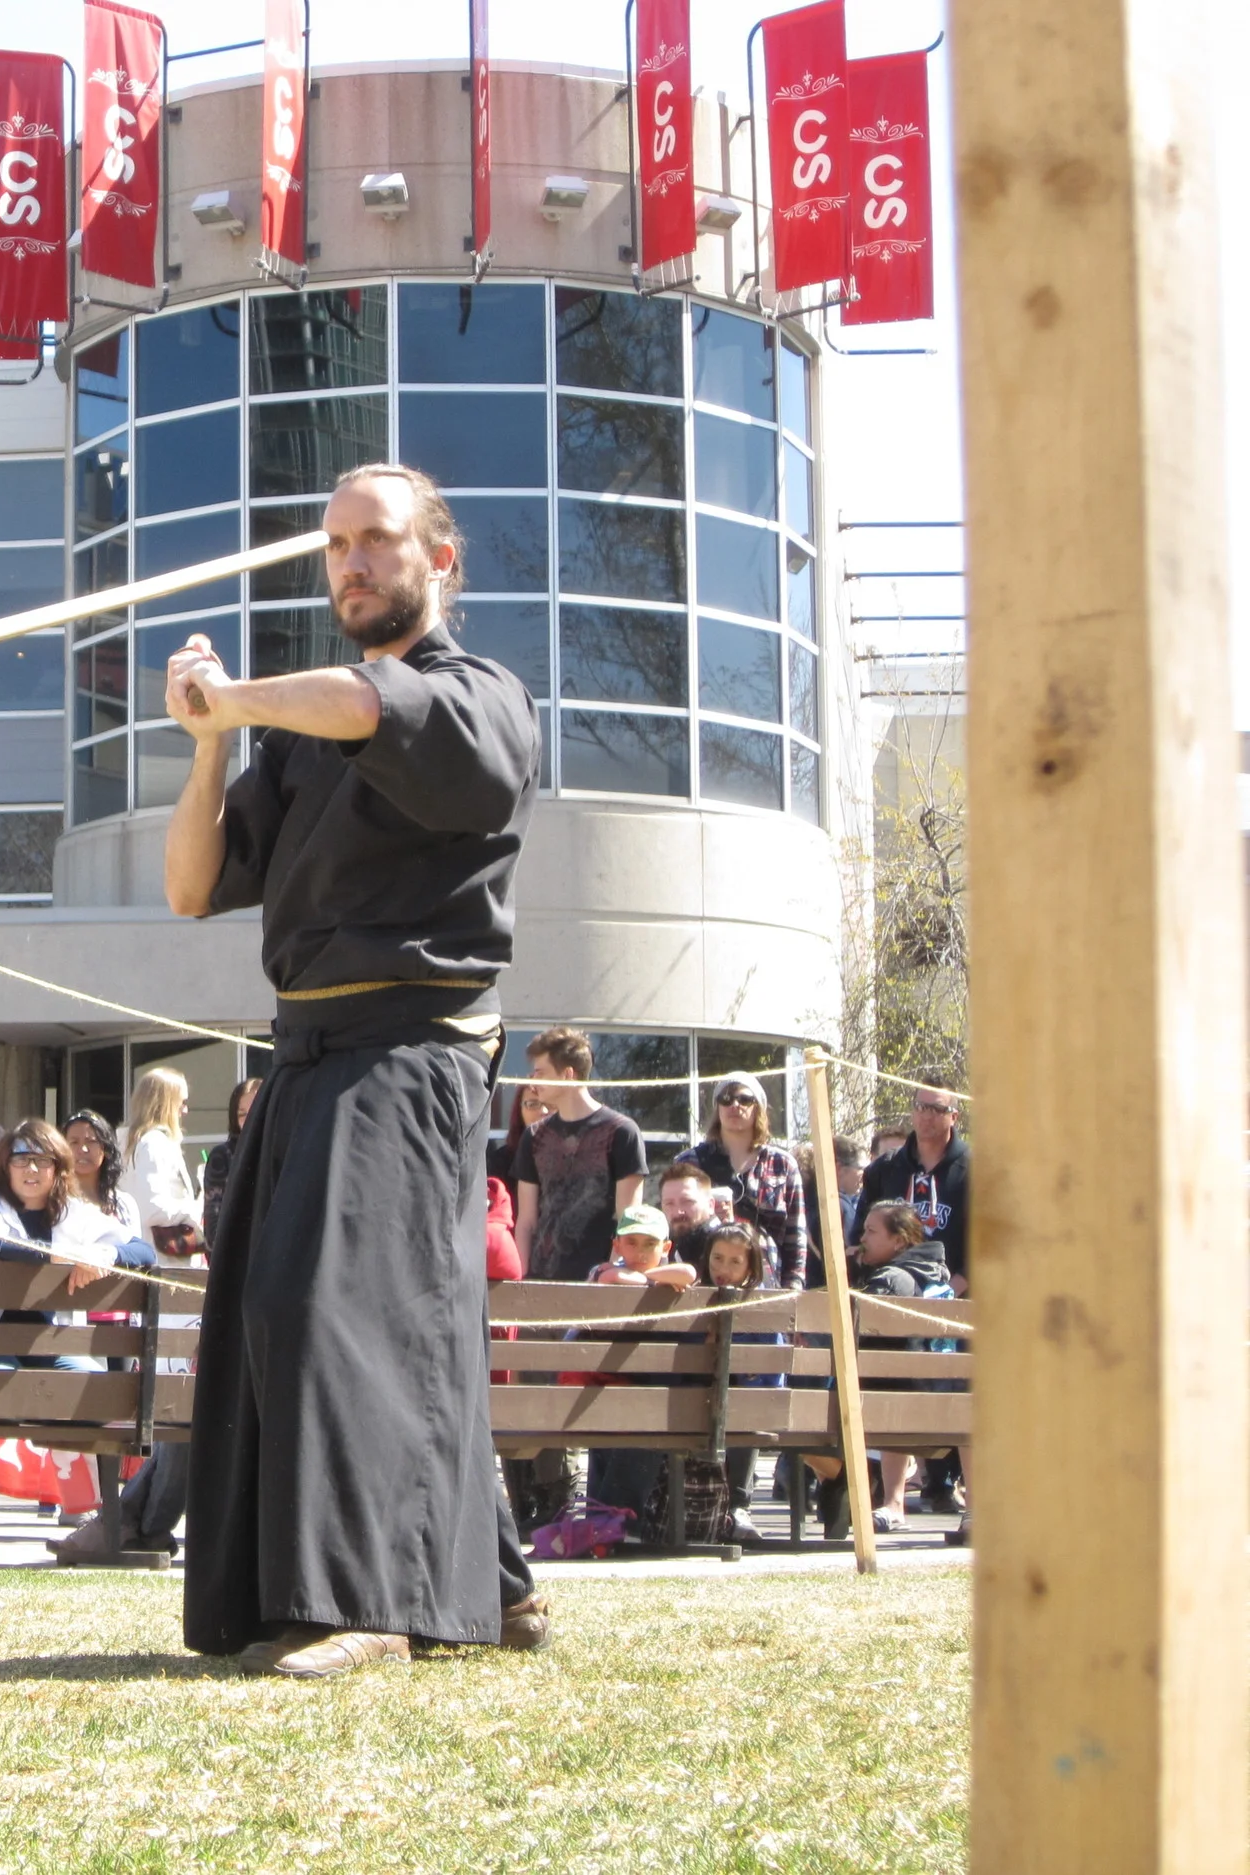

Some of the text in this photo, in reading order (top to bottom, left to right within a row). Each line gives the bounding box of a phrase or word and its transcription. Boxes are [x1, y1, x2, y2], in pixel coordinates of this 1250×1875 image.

[653, 80, 676, 163] CS
[793, 109, 832, 189] CS
[863, 154, 908, 229] CS
